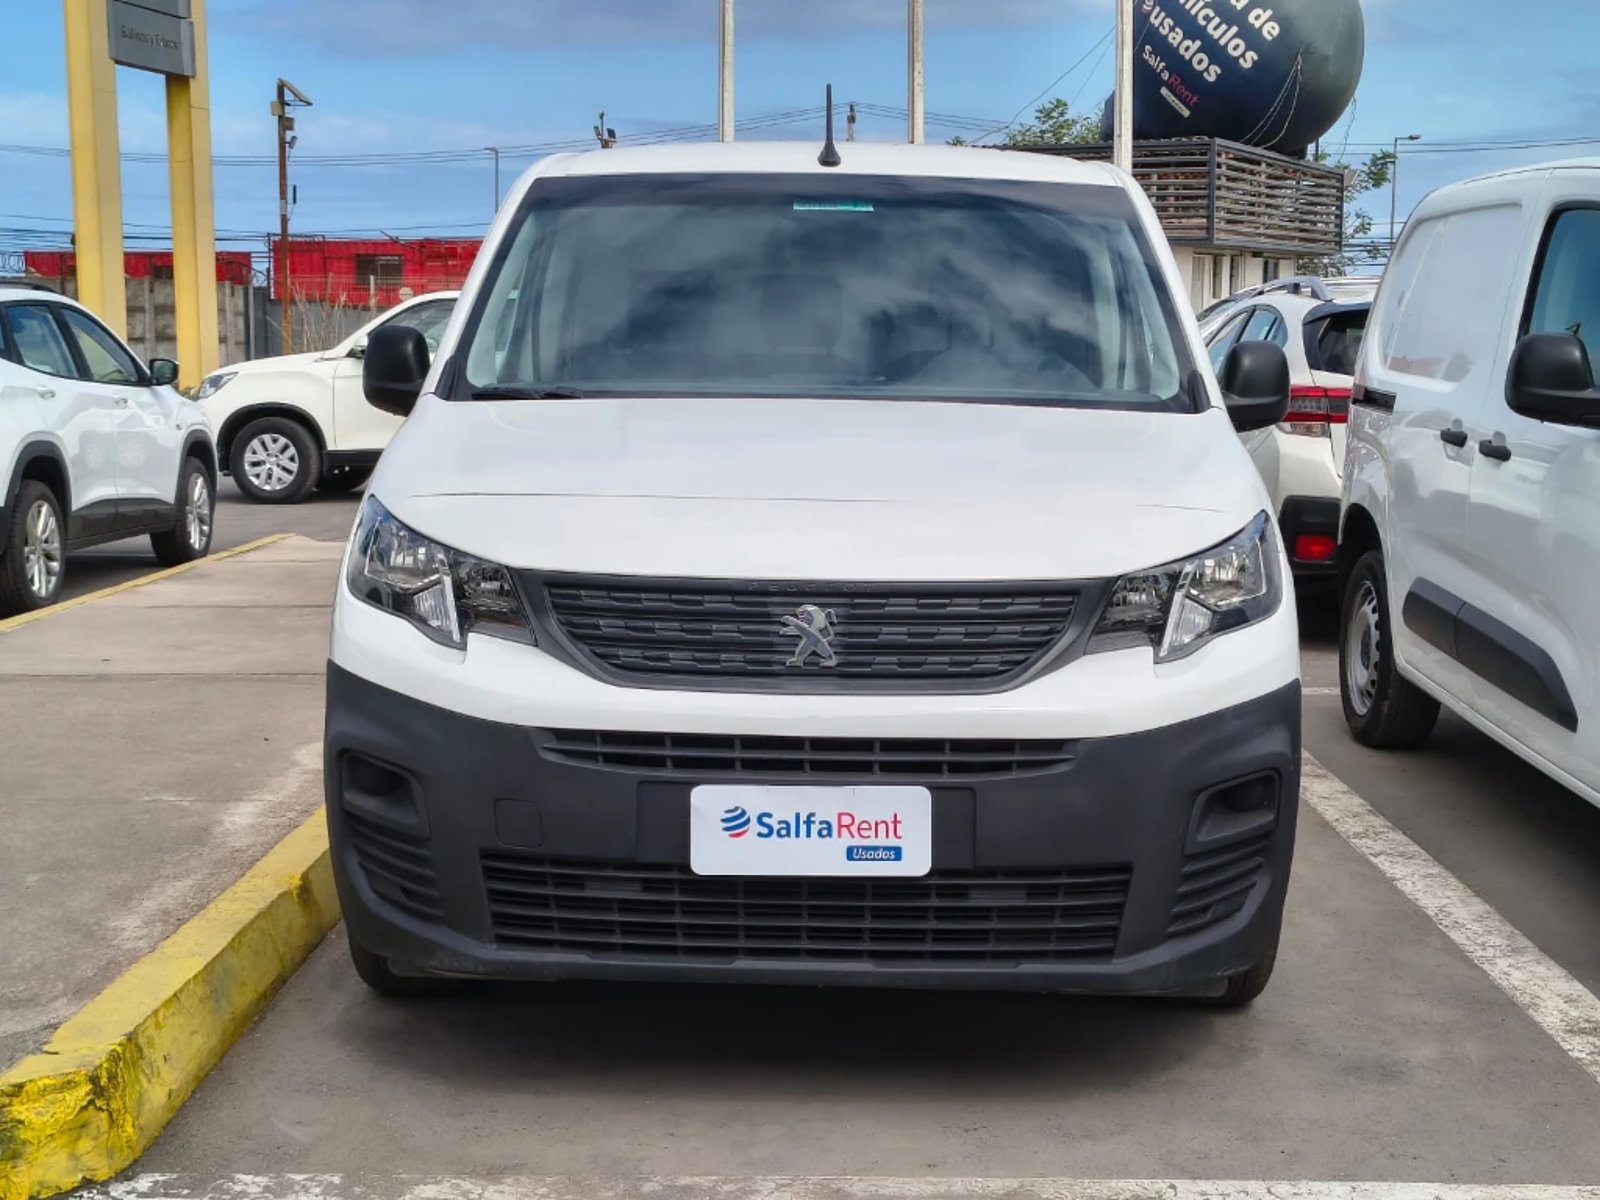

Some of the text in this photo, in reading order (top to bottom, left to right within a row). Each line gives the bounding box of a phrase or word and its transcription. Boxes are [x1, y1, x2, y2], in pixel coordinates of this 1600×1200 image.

[1248, 8, 1280, 41] de
[1150, 5, 1222, 82] usados
[756, 812, 903, 839] SalfaRent
[852, 848, 896, 860] Usados
